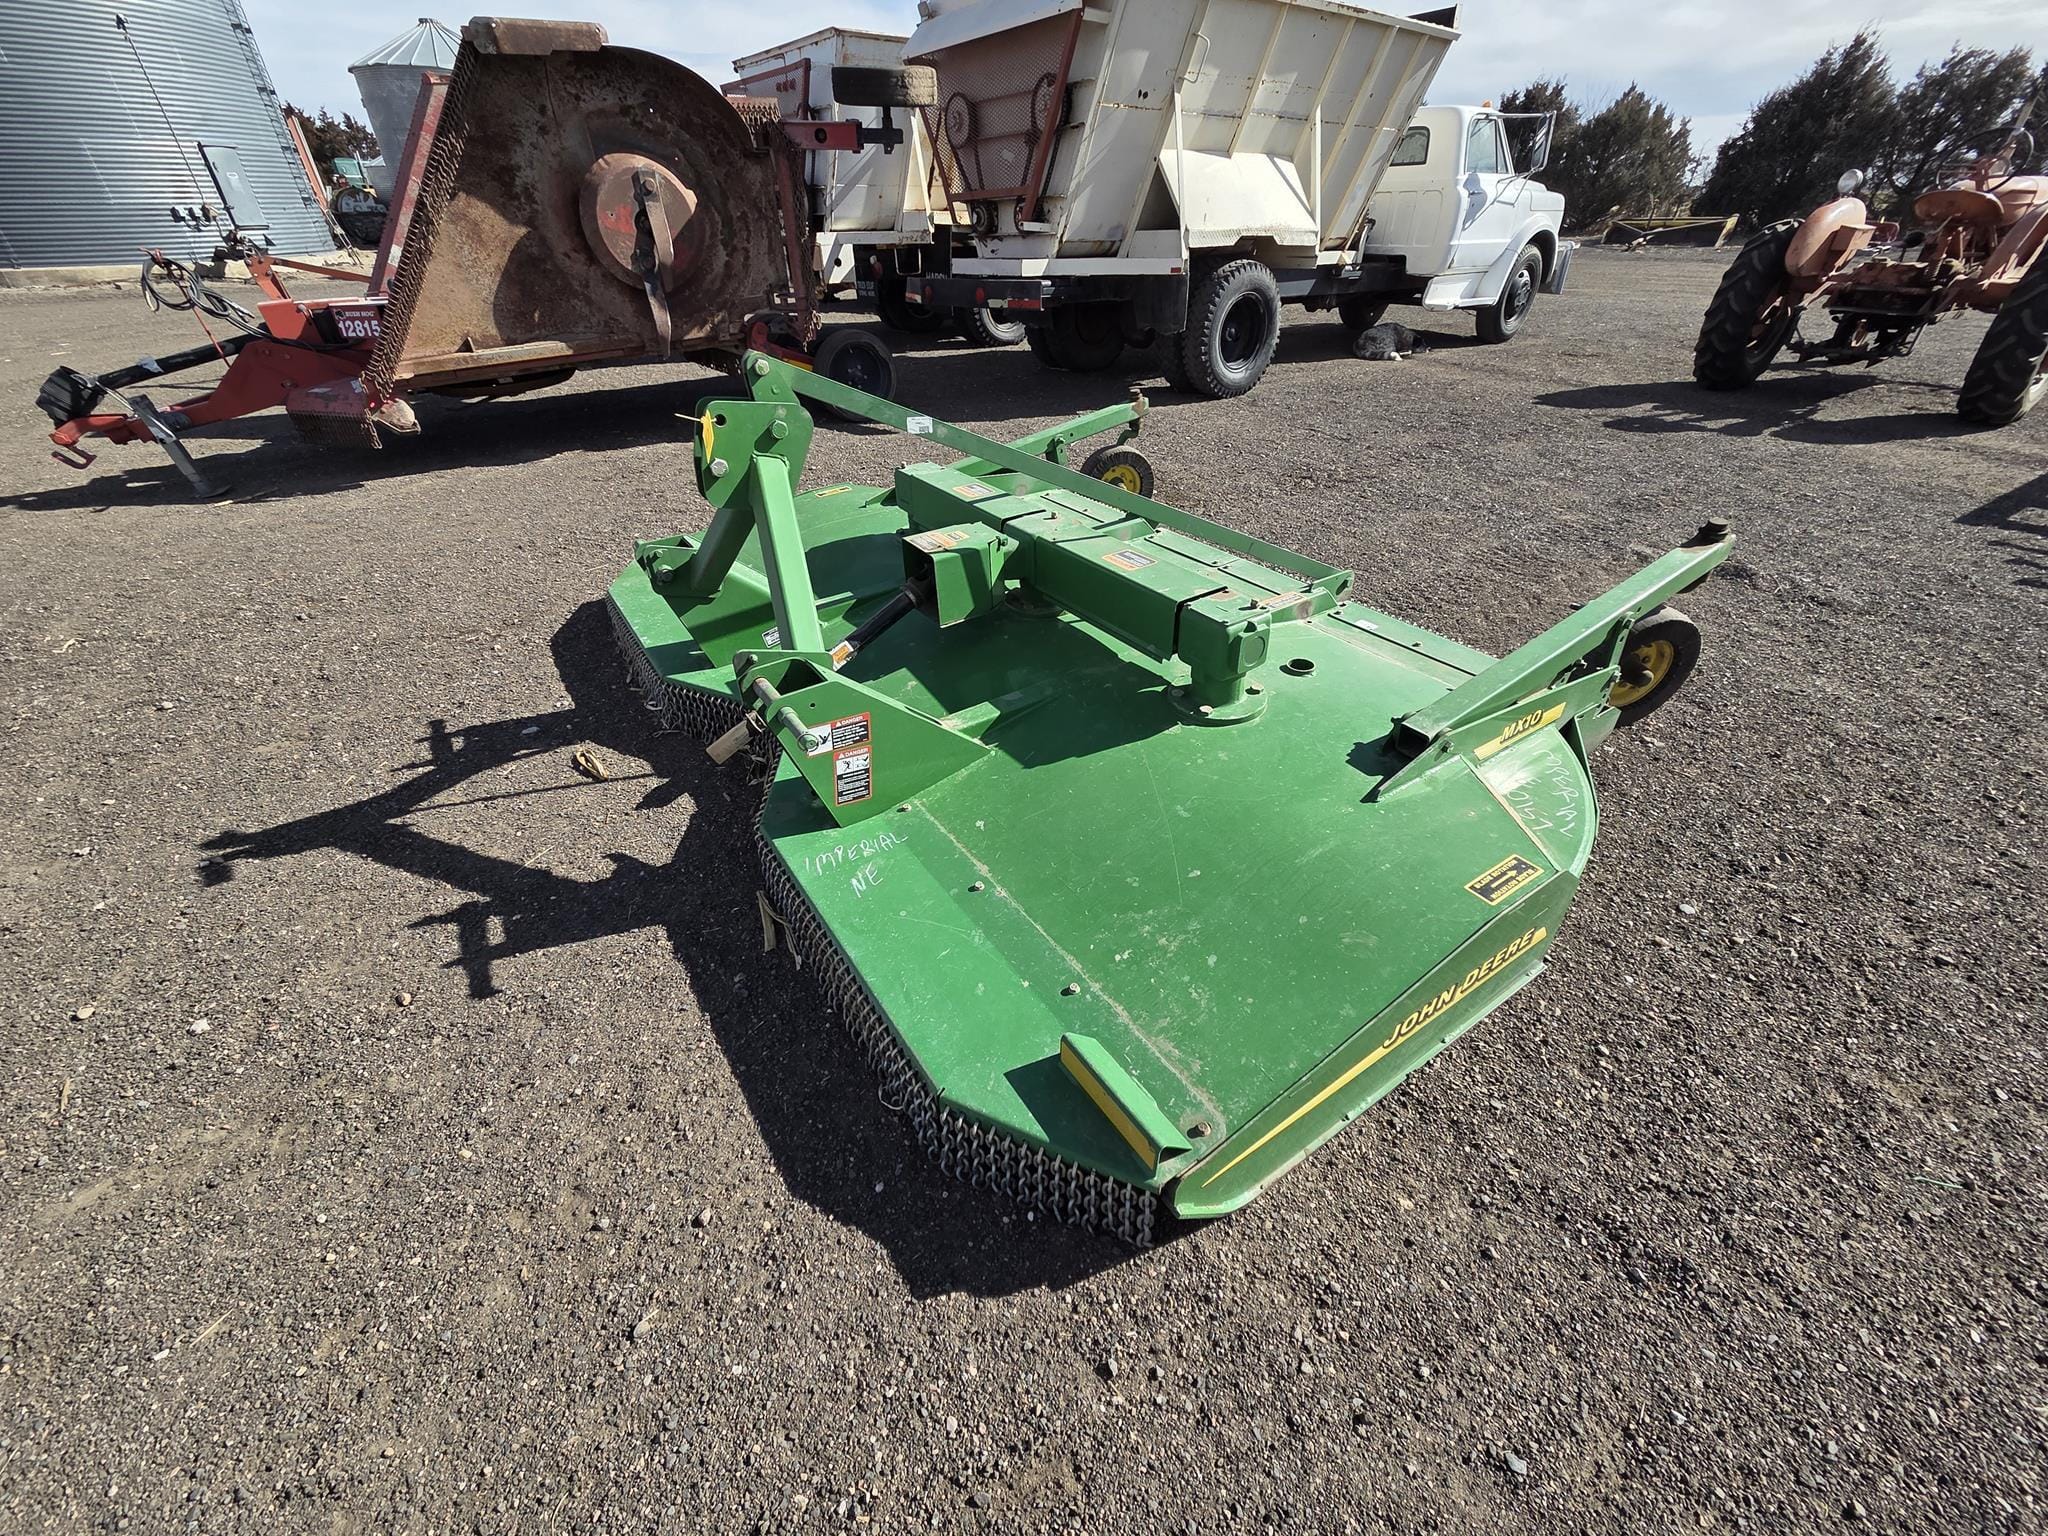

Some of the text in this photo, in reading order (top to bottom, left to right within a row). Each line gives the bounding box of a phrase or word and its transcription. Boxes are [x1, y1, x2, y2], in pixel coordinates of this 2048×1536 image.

[339, 320, 381, 337] 12815
[841, 715, 864, 725] DANGER
[1500, 709, 1543, 744] MX10
[844, 747, 869, 758] DANGER
[804, 832, 909, 877] IMPERIAL
[851, 861, 884, 898] NE
[1383, 927, 1535, 1049] JOHN DEERE
